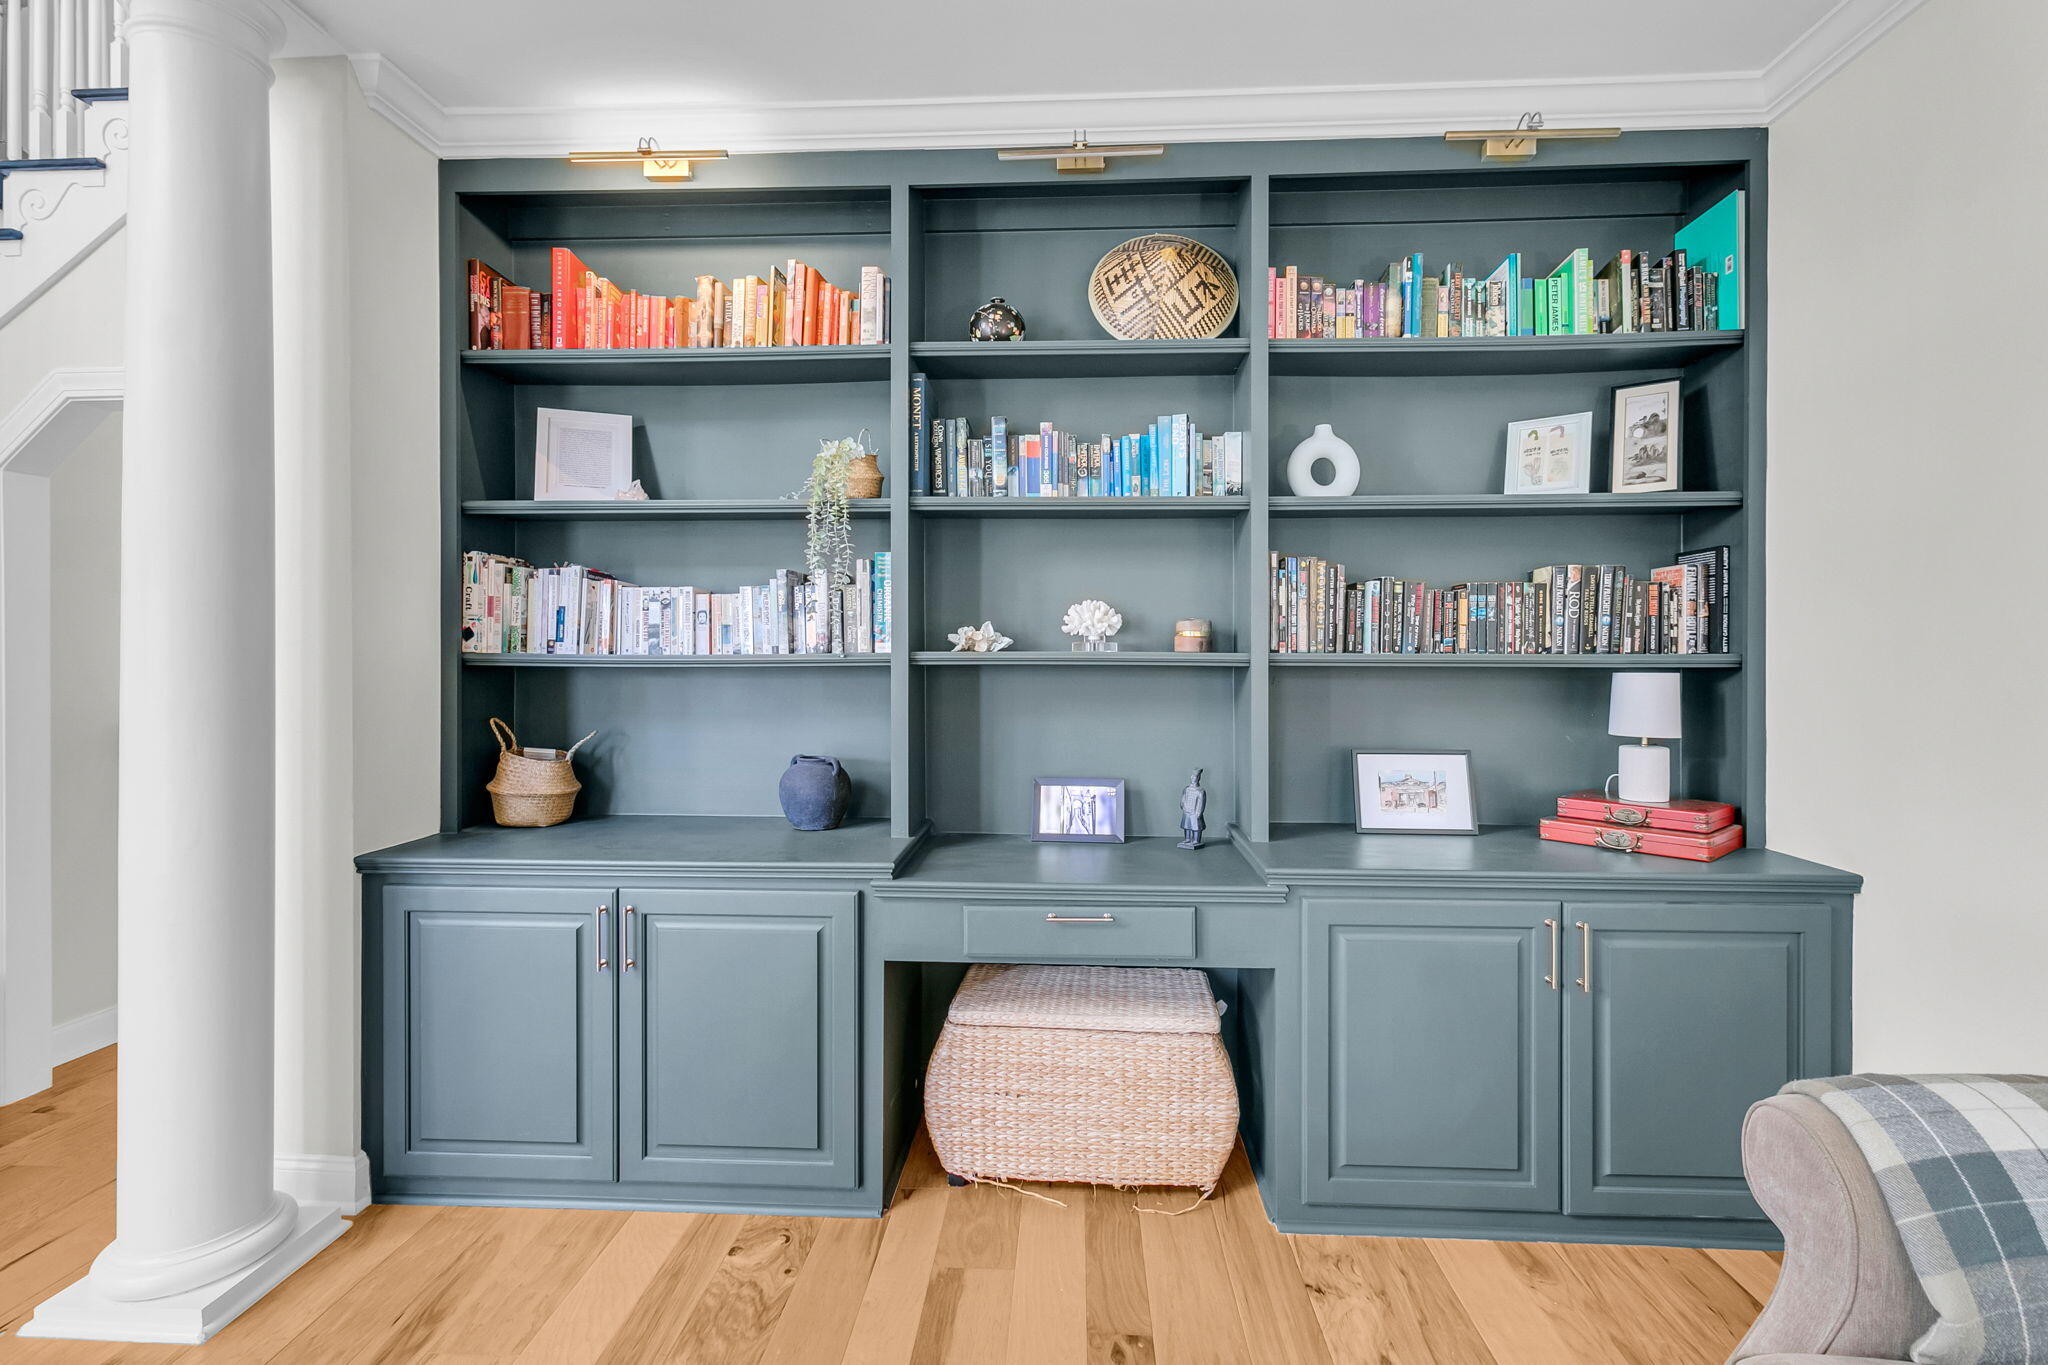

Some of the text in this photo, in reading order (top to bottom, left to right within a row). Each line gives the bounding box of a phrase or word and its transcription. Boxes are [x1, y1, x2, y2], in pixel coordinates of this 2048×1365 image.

[863, 272, 871, 300] KING
[1492, 282, 1502, 306] Tolkien
[1678, 266, 1687, 326] Digital Photography
[912, 387, 922, 429] MONET
[1556, 574, 1564, 589] TERRY
[1556, 589, 1564, 616] PRATCHETT
[1568, 591, 1580, 618] ROD
[1584, 601, 1589, 609] OF
[1602, 573, 1612, 646] TERRY PRATCHETT NATION
[1686, 567, 1696, 640] FRANKIE BOYLE
